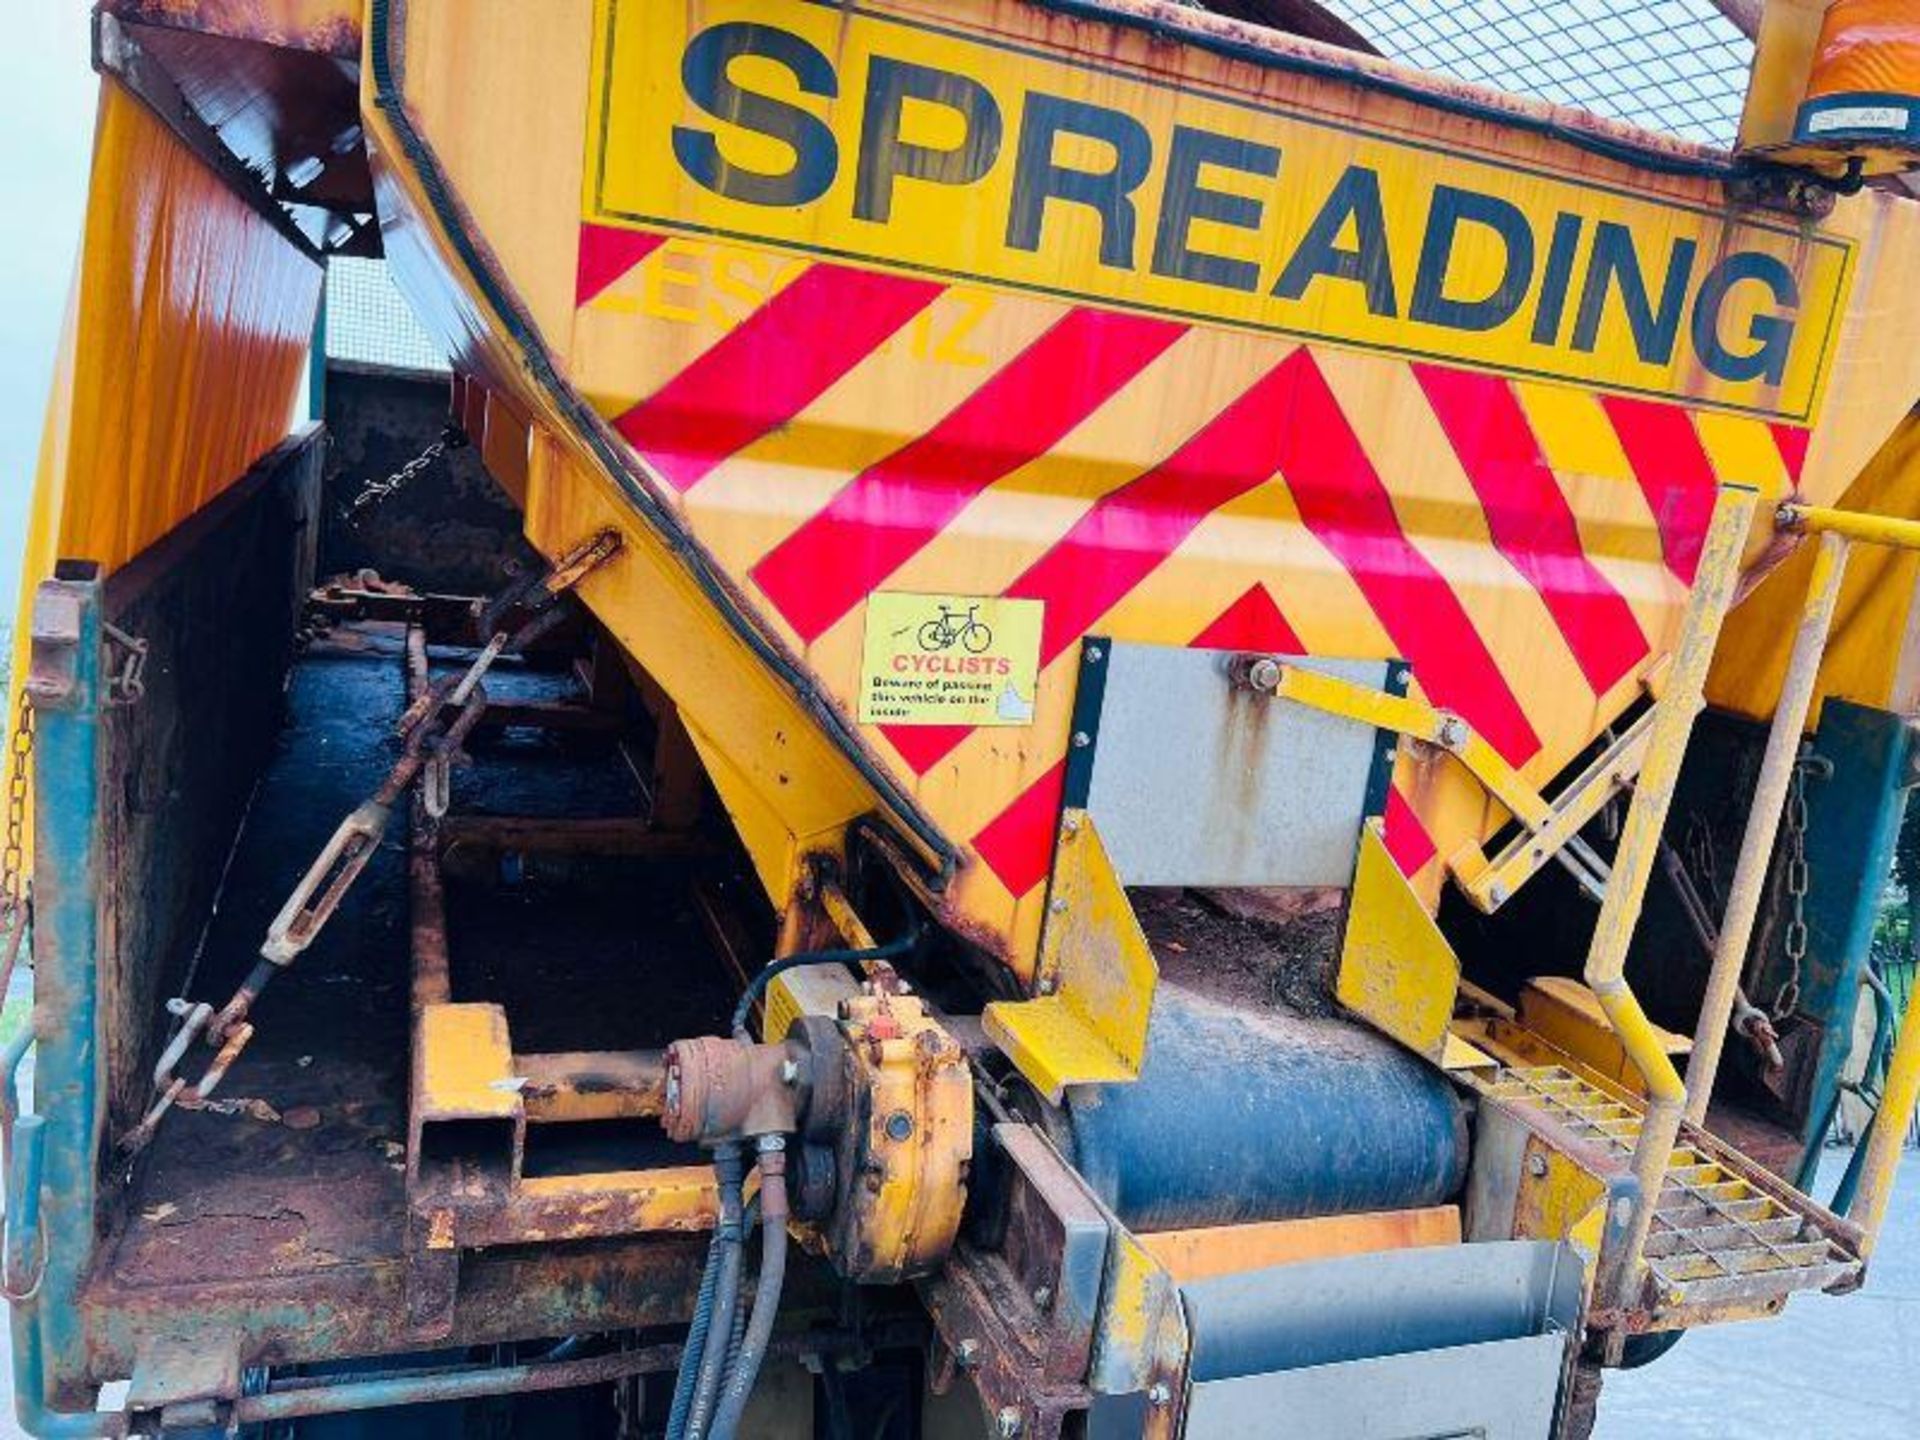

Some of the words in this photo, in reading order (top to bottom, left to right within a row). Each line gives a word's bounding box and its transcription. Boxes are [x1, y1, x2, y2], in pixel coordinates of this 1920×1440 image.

[671, 21, 1799, 386] SPREADING
[892, 654, 1010, 675] CYCLISTS
[873, 676, 922, 688] Beware
[926, 679, 940, 688] of
[872, 692, 896, 702] this
[899, 693, 946, 704] vehicle
[949, 695, 965, 704] on
